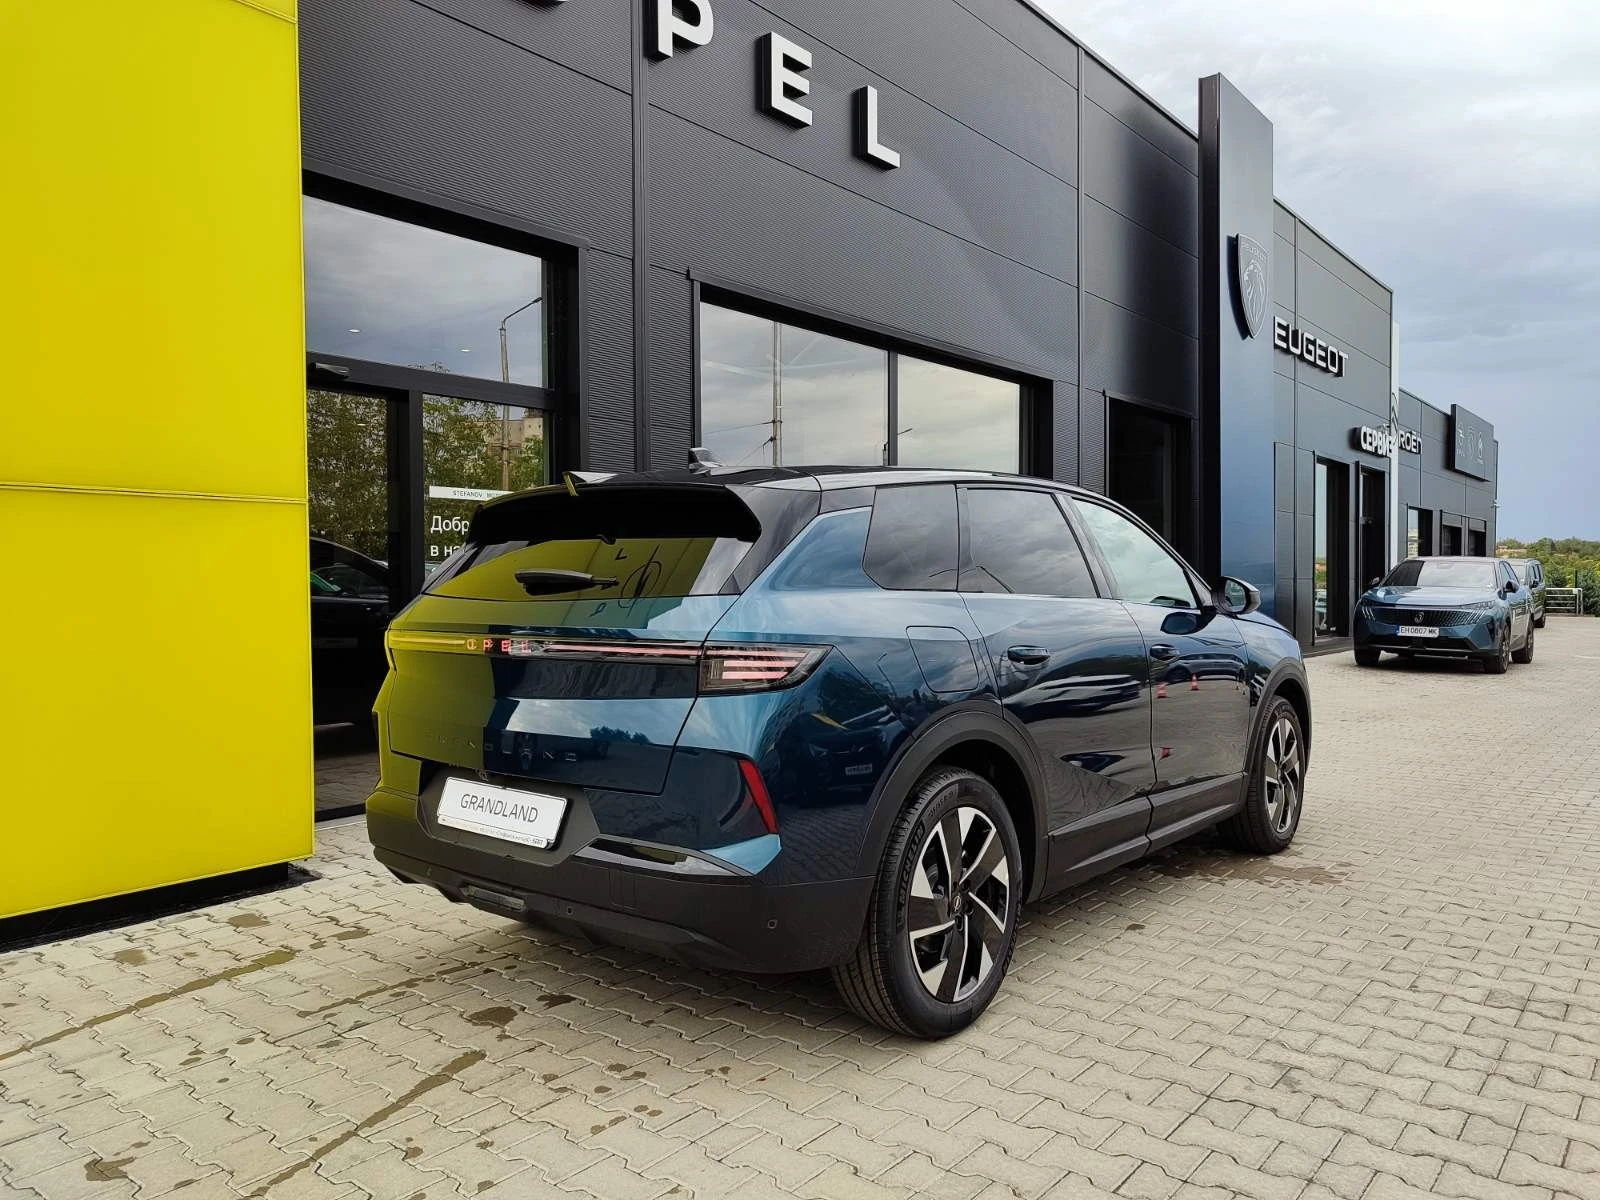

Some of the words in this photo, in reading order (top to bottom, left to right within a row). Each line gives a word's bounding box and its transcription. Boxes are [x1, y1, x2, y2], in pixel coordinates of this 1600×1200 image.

[548, 0, 900, 168] PEL
[1273, 316, 1348, 377] EUGEOT
[1399, 430, 1422, 455] ROËN
[430, 515, 470, 535] Добр
[460, 793, 538, 823] GRANDLAND
